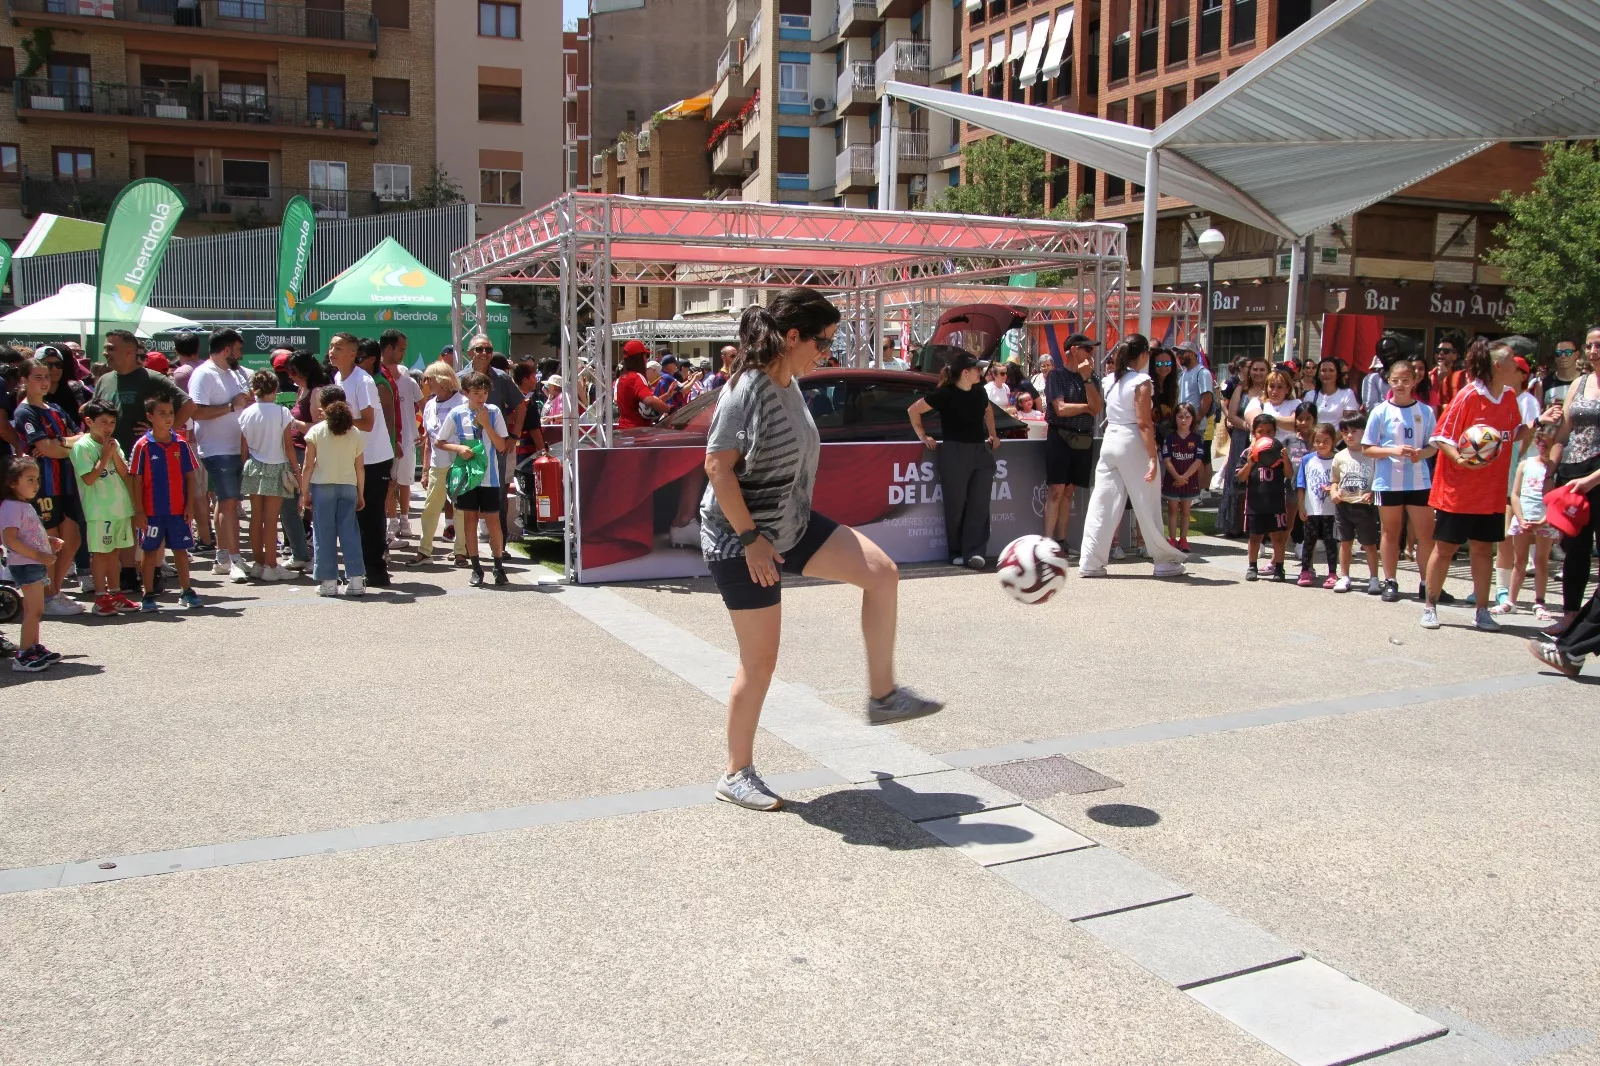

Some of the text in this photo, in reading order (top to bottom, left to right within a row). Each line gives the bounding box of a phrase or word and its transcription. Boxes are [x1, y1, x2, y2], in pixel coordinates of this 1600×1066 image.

[125, 203, 170, 284] Iberdrola
[289, 220, 310, 292] Iberdrola
[371, 293, 435, 303] Iberdrola
[1212, 290, 1240, 310] Bar
[1364, 289, 1400, 311] Bar
[1429, 292, 1466, 318] San
[320, 310, 366, 322] Iberdrola
[393, 311, 438, 322] Iberdrola
[465, 312, 508, 323] Ibdrola
[1404, 428, 1413, 439] 10
[893, 461, 935, 482] LAS
[1258, 467, 1274, 482] 10
[888, 483, 944, 505] DE LA
[36, 497, 53, 512] 10
[104, 521, 112, 534] 7
[891, 517, 923, 527] QUIERES
[1275, 513, 1287, 528] 10
[147, 525, 159, 538] 10
[908, 528, 934, 537] ENTRA
